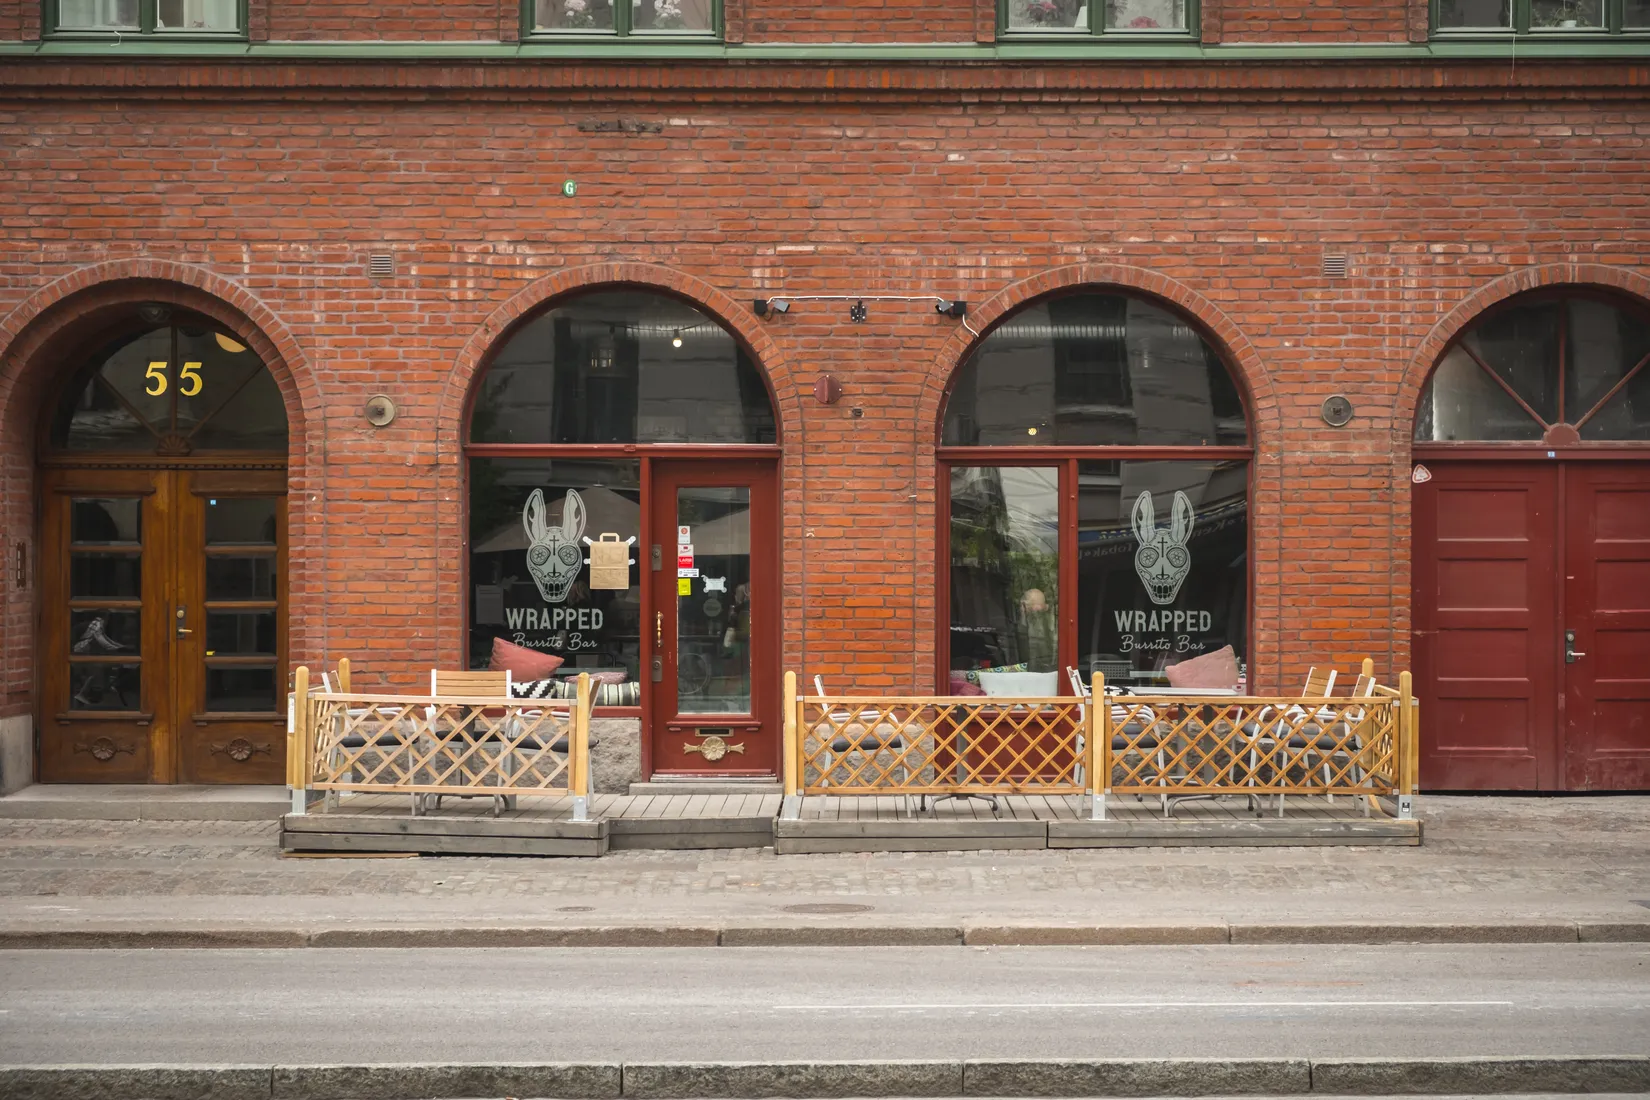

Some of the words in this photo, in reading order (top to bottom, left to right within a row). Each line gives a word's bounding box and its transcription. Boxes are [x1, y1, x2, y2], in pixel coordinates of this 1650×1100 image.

[565, 181, 574, 195] G
[145, 361, 203, 397] 55
[505, 608, 604, 630] WRAPPED
[1114, 610, 1212, 632] WRAPPED
[512, 632, 563, 651] Burrito
[567, 632, 598, 651] Bar
[1119, 634, 1172, 653] Burrito
[1175, 634, 1206, 653] Bar
